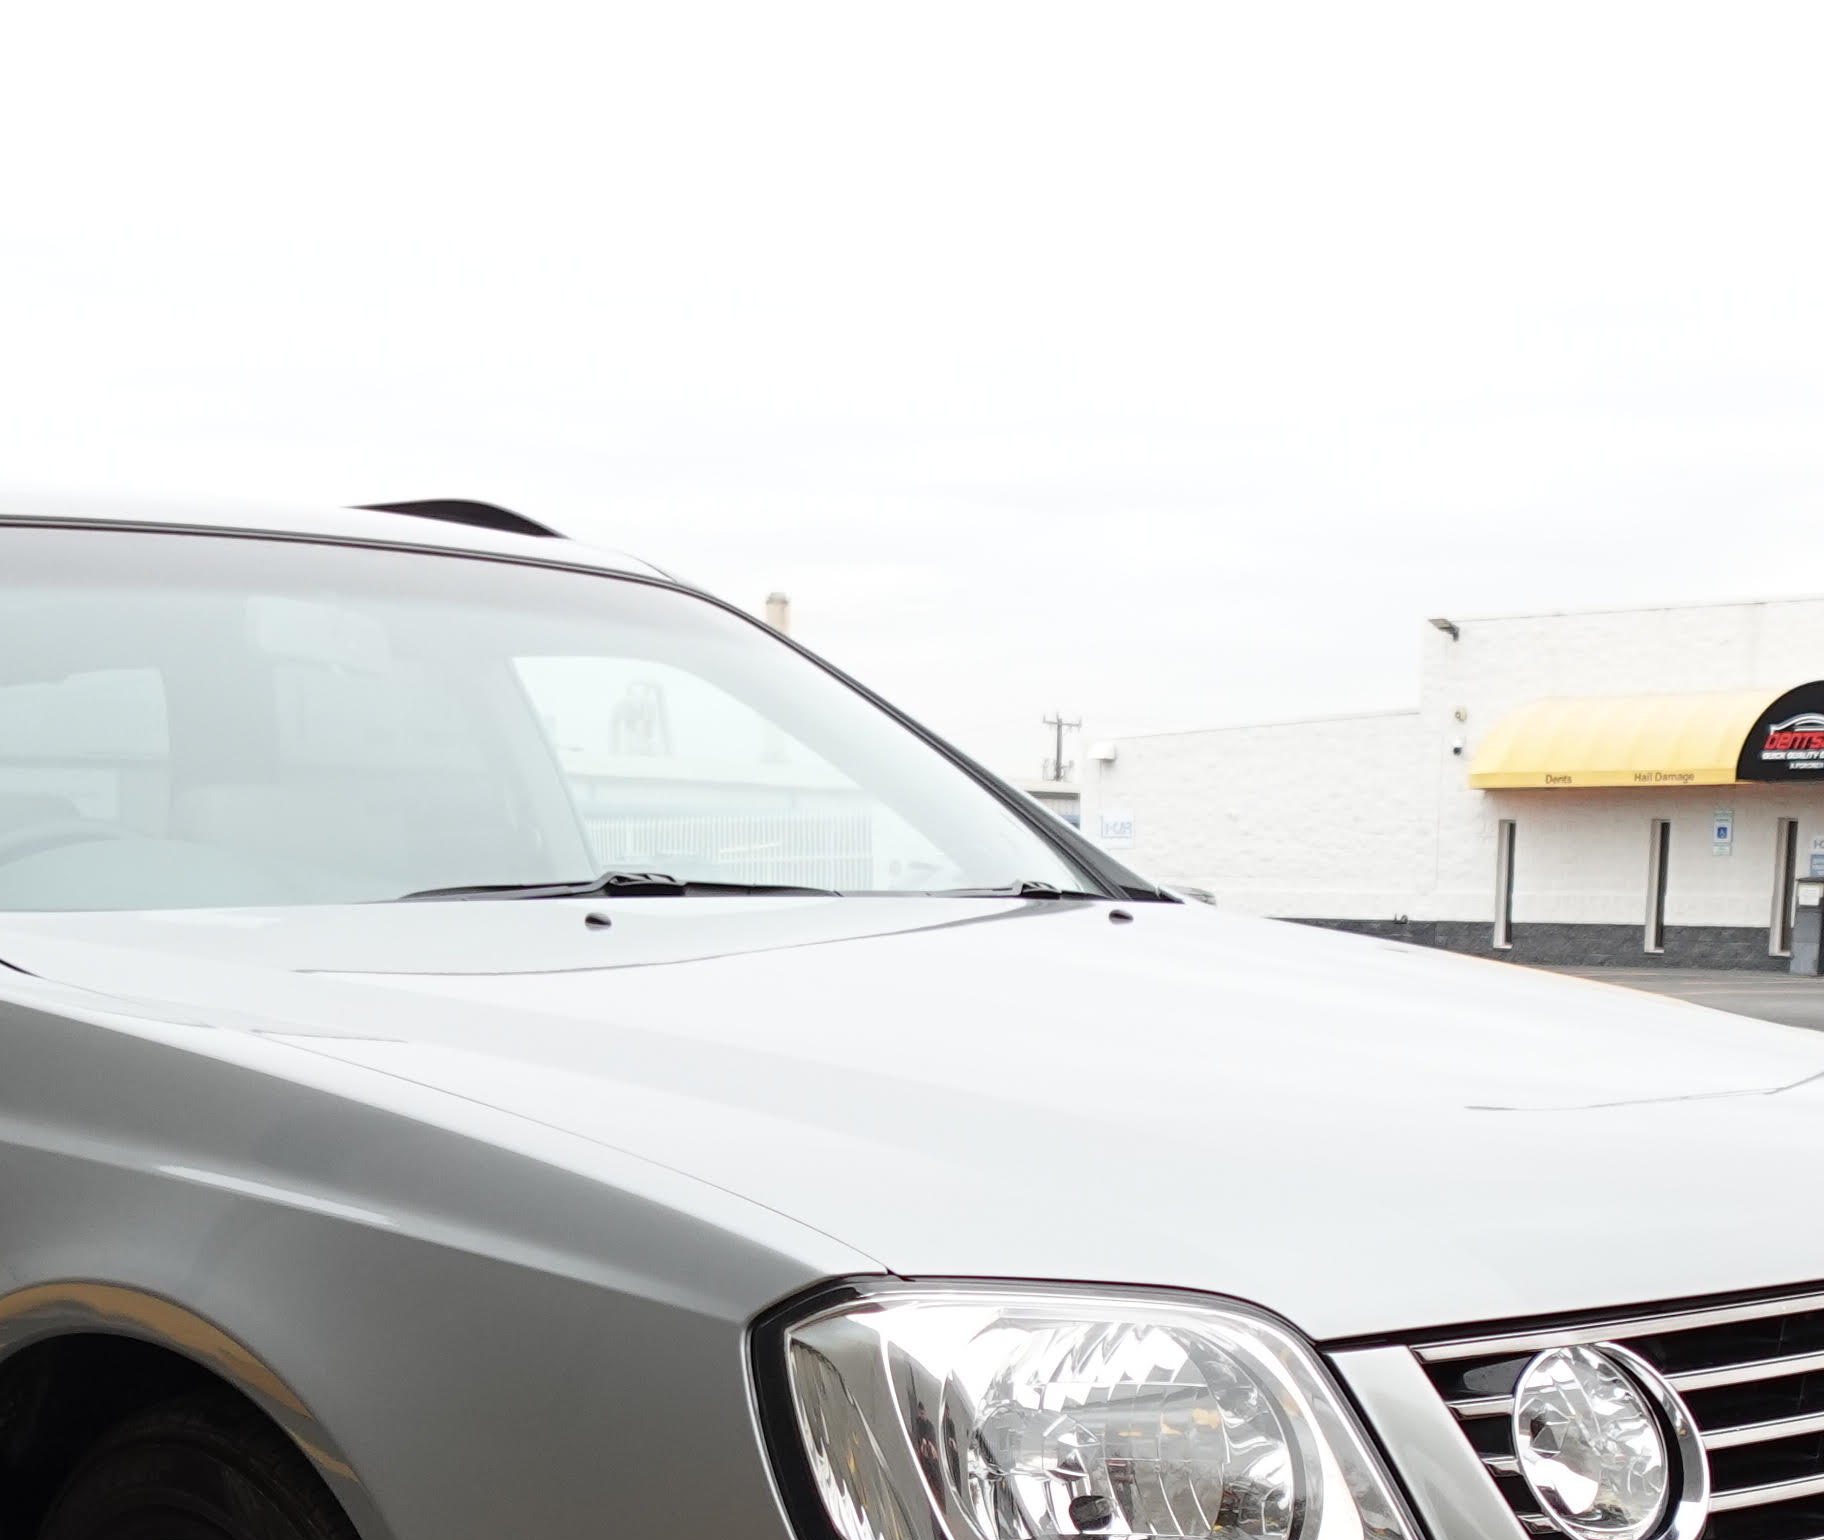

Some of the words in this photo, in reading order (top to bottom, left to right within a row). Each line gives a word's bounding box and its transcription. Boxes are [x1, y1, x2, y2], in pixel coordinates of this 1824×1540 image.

[1545, 774, 1573, 785] Dents
[1634, 772, 1653, 783] Hail
[1655, 771, 1695, 784] Damage
